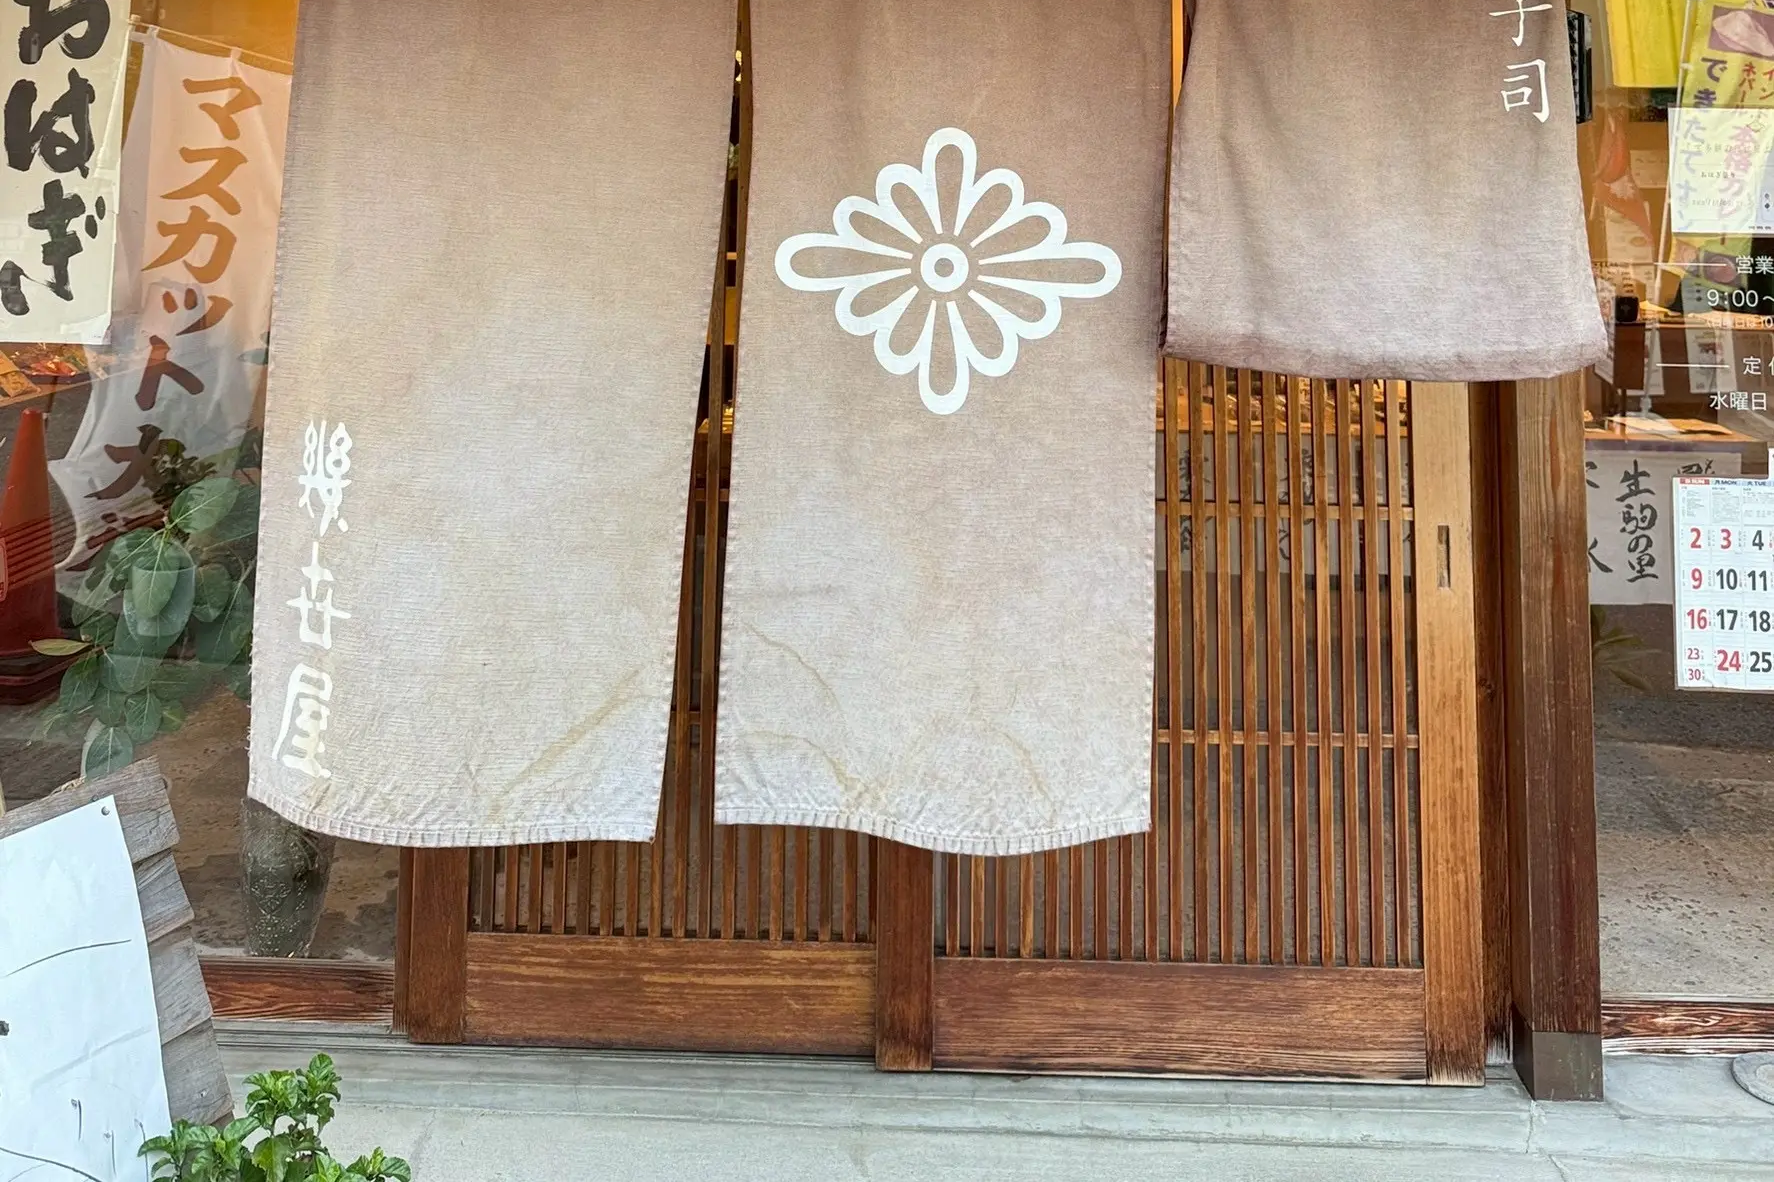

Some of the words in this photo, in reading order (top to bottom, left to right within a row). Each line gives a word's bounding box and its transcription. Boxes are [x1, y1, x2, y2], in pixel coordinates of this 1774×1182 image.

[1709, 391, 1767, 411] 水曜日
[1615, 459, 1659, 583] 生駒の里
[1690, 527, 1702, 549] 2
[1720, 528, 1732, 550] 3
[1752, 529, 1764, 551] 4
[1691, 567, 1703, 590] 9
[1716, 568, 1738, 591] 10
[1747, 569, 1768, 591] 11
[1687, 608, 1708, 630] 16
[1716, 608, 1738, 630] 17
[1748, 610, 1771, 633] 18
[1687, 647, 1700, 660] 23
[1717, 649, 1741, 672] 24
[1749, 650, 1772, 673] 25
[1688, 668, 1701, 681] 30
